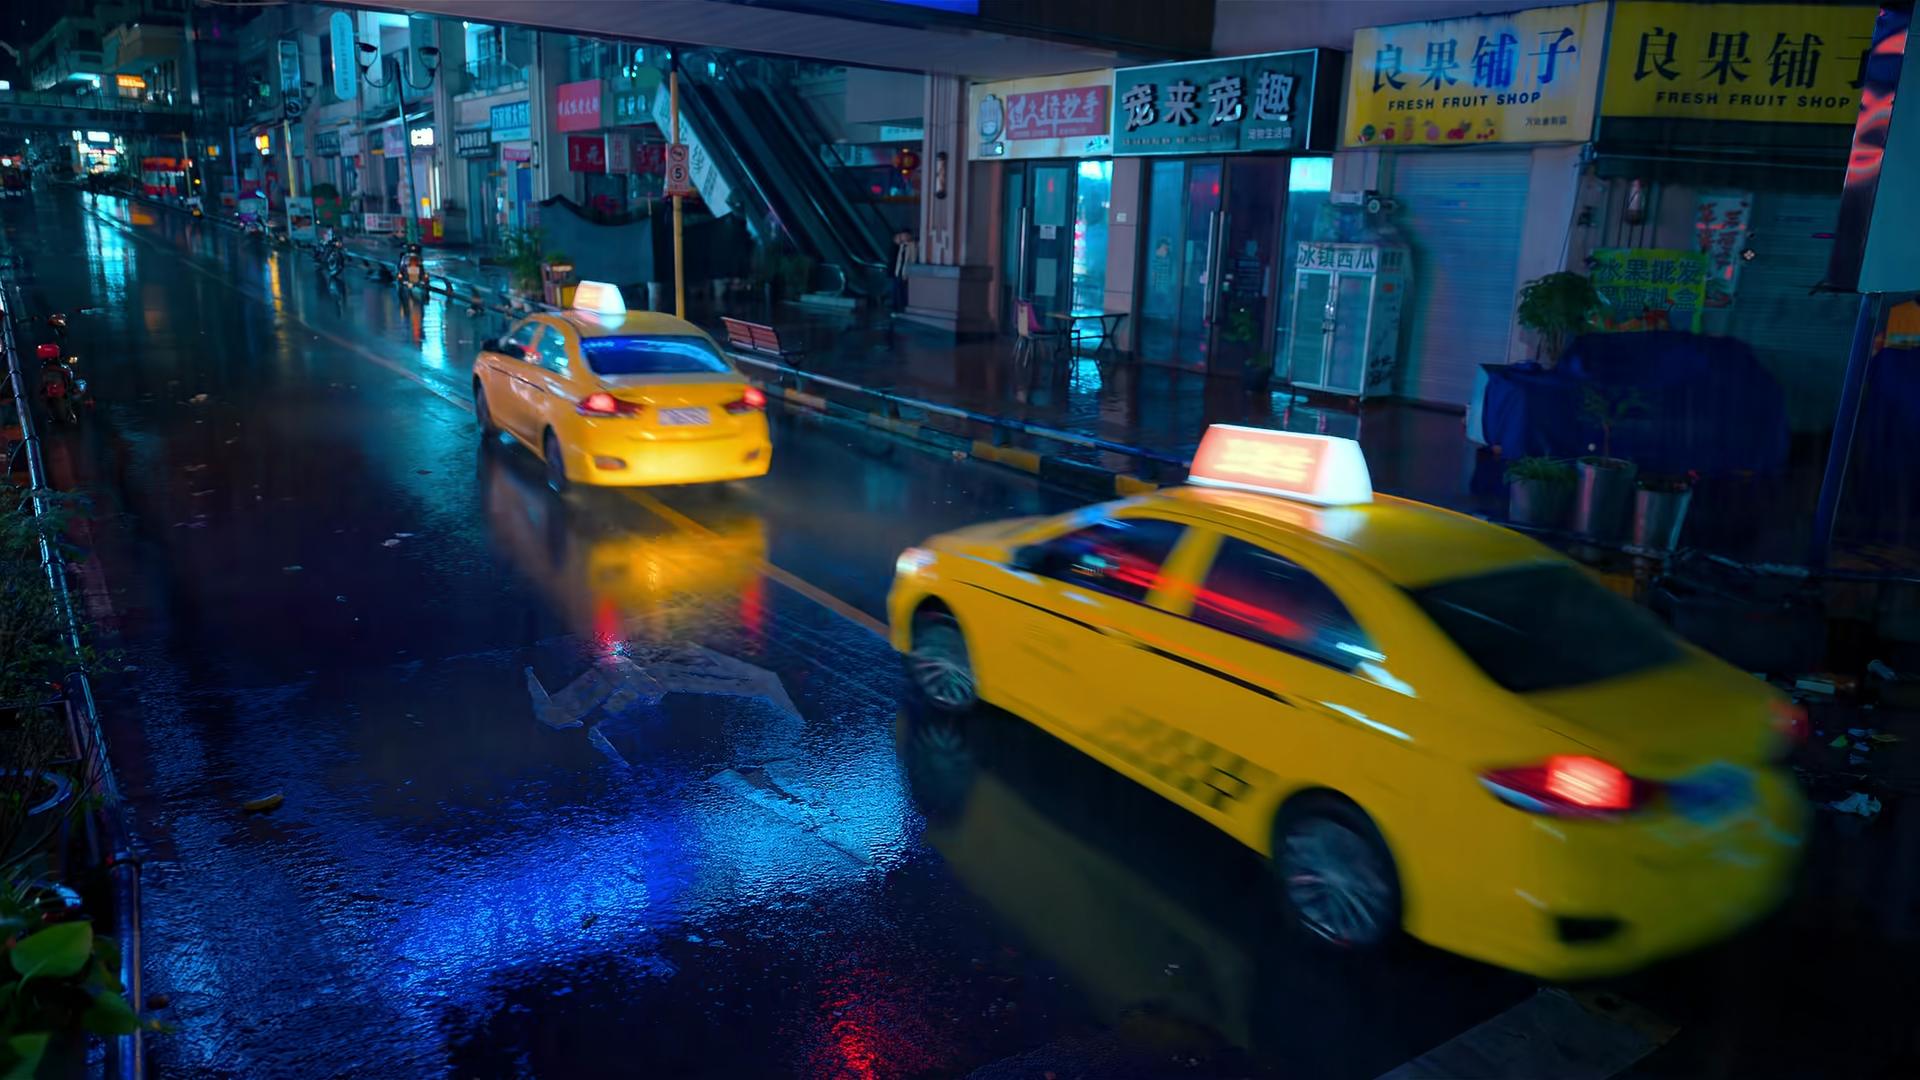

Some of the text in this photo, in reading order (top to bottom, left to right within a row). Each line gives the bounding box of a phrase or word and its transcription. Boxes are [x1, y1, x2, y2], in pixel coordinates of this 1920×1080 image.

[1372, 27, 1576, 93] 良果铺子
[1122, 71, 1294, 130] 宠来宠趣
[1388, 91, 1541, 111] FRESH FRUIT SHOP
[1656, 91, 1850, 108] FRESH FRUIT SHOP
[674, 167, 682, 179] 5
[1298, 246, 1375, 269] 冰镇西瓜
